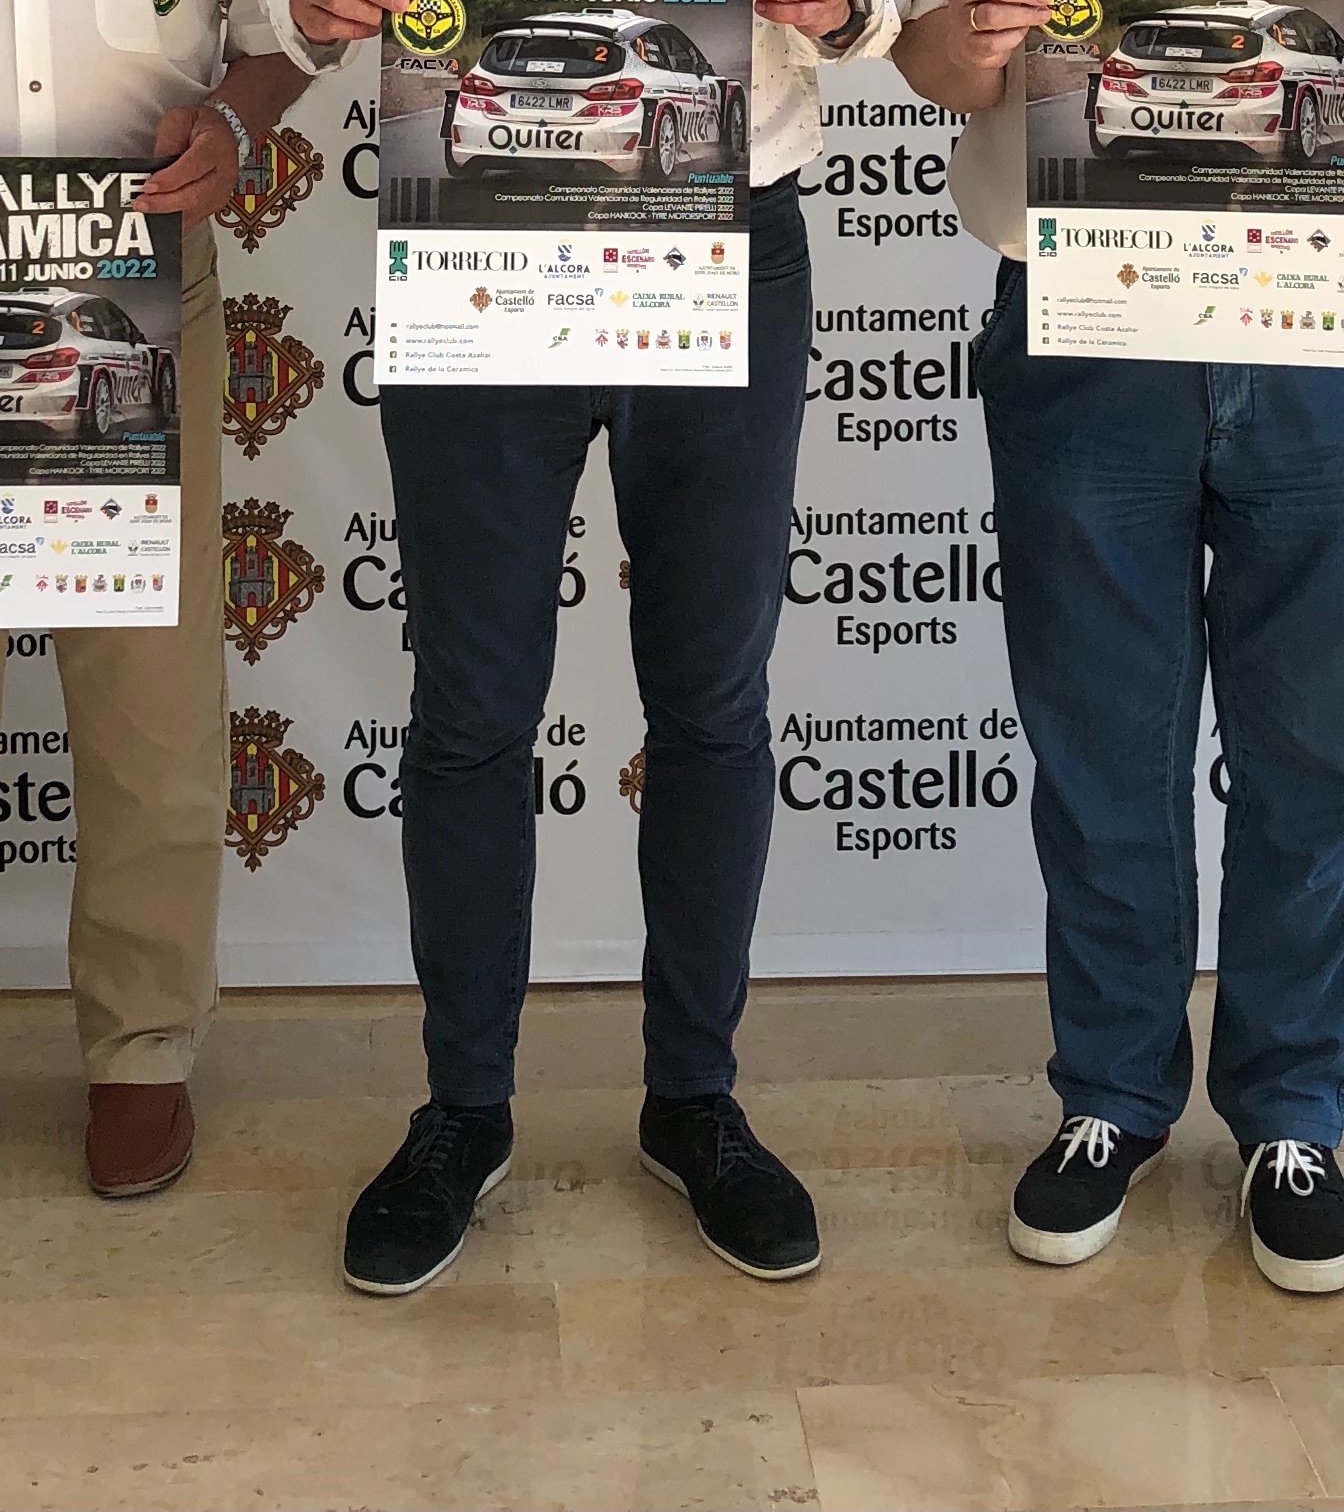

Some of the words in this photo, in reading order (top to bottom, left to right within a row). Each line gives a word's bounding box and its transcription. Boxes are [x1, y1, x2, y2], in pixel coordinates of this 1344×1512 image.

[23, 263, 93, 282] JUNIO
[97, 258, 156, 279] 2022
[412, 250, 528, 272] TORRECID
[779, 712, 969, 752] Ajuntament
[979, 707, 1019, 740] de
[778, 749, 1019, 812] Castelló
[836, 821, 957, 860] Esports
